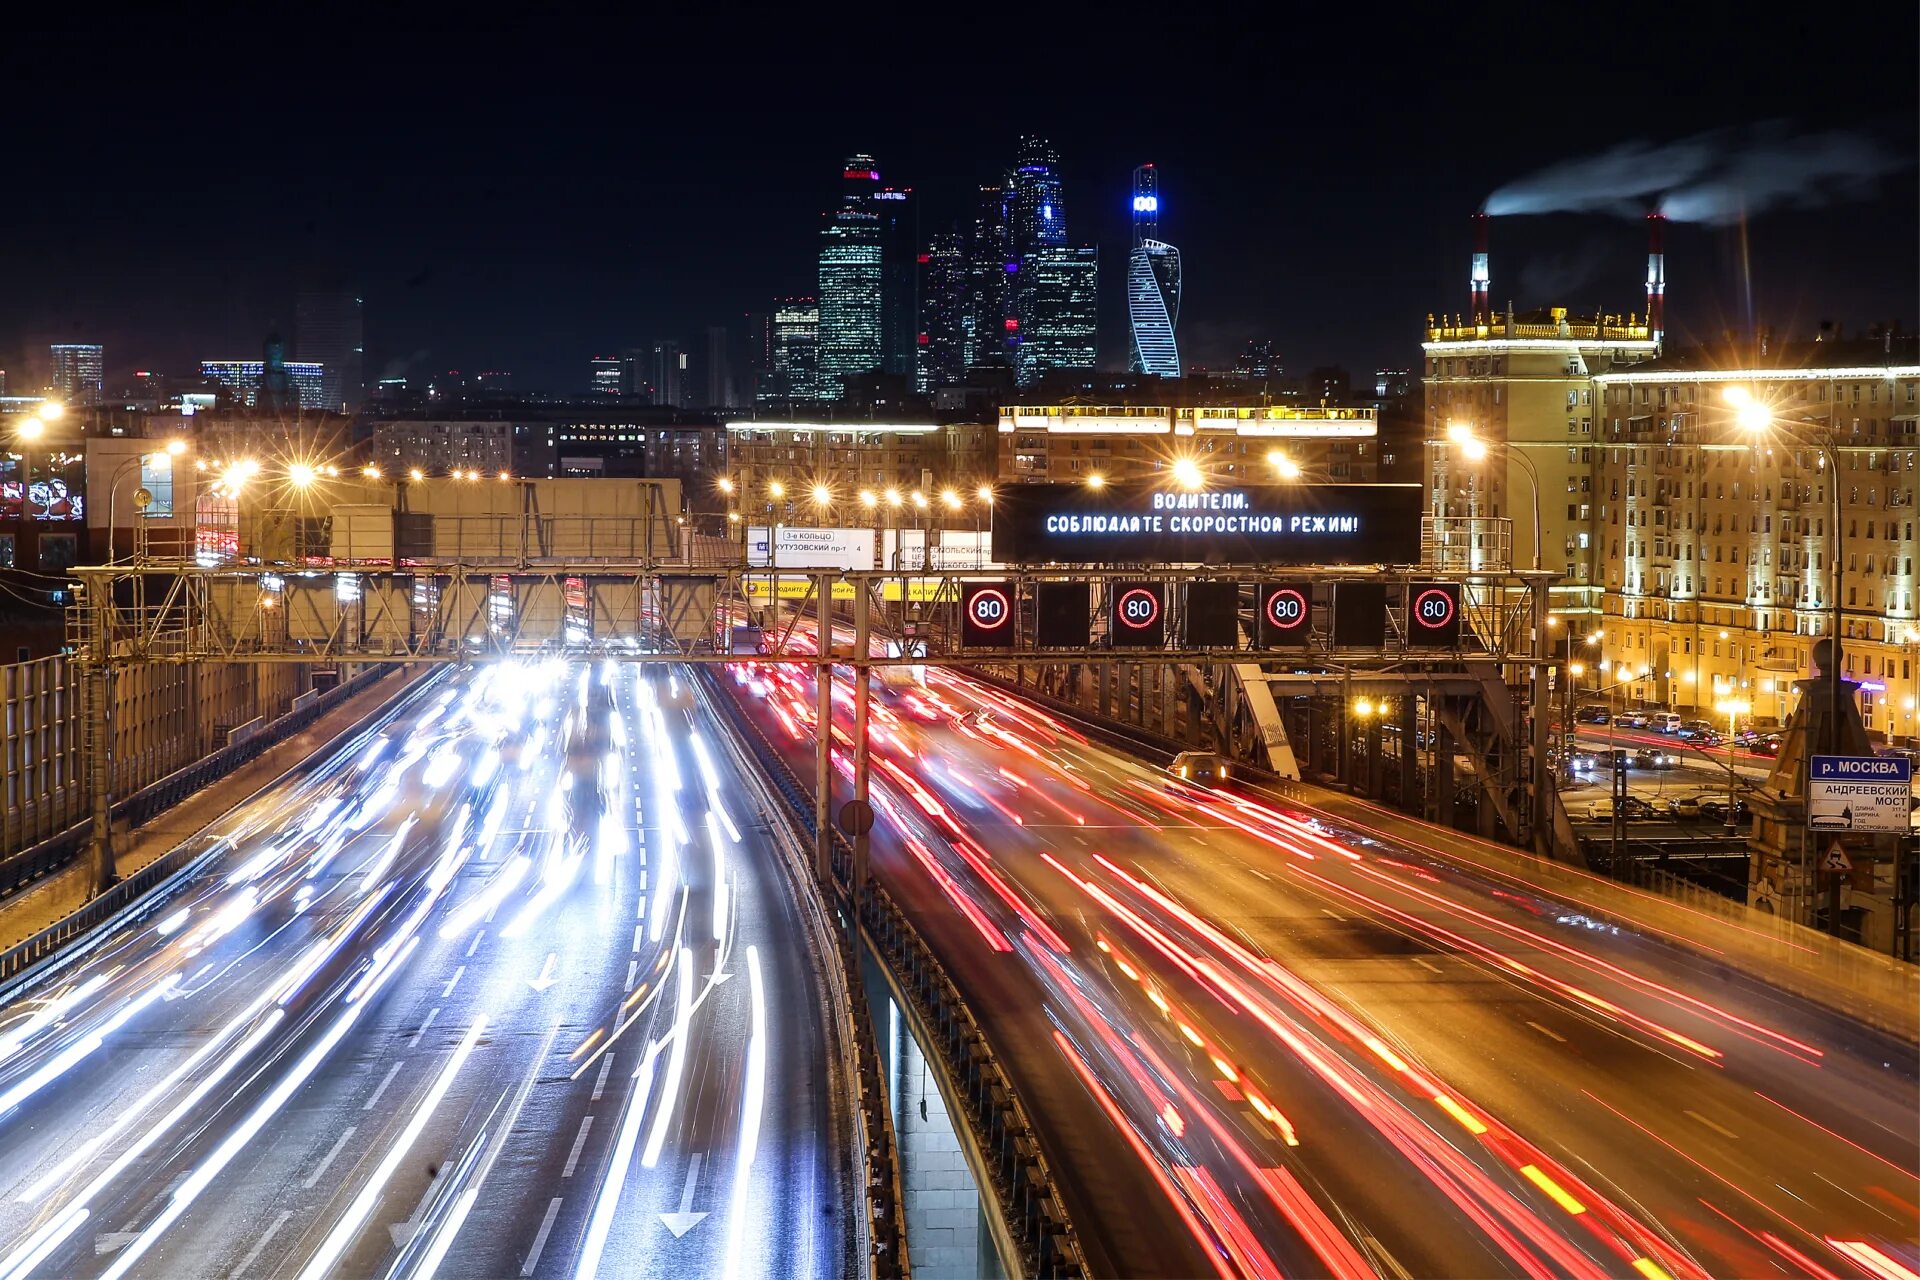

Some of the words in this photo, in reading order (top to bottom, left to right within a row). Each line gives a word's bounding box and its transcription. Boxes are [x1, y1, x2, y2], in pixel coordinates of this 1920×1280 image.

[1047, 516, 1163, 533] СОБЛЮДАЙТЕ
[1170, 516, 1283, 533] СКОРОСТНОЙ
[1291, 516, 1358, 533] РЕЖИМ!
[799, 532, 832, 541] КОЛЬЦО
[977, 600, 1001, 618] 80
[1127, 600, 1150, 617] 80
[1275, 600, 1298, 617] 80
[1423, 600, 1446, 617] 80
[1822, 763, 1835, 774] р.
[1838, 761, 1899, 774] МОСКВА
[1825, 784, 1908, 796] АНДРЕЕВСКИЙ
[1875, 796, 1907, 807] МОСТ
